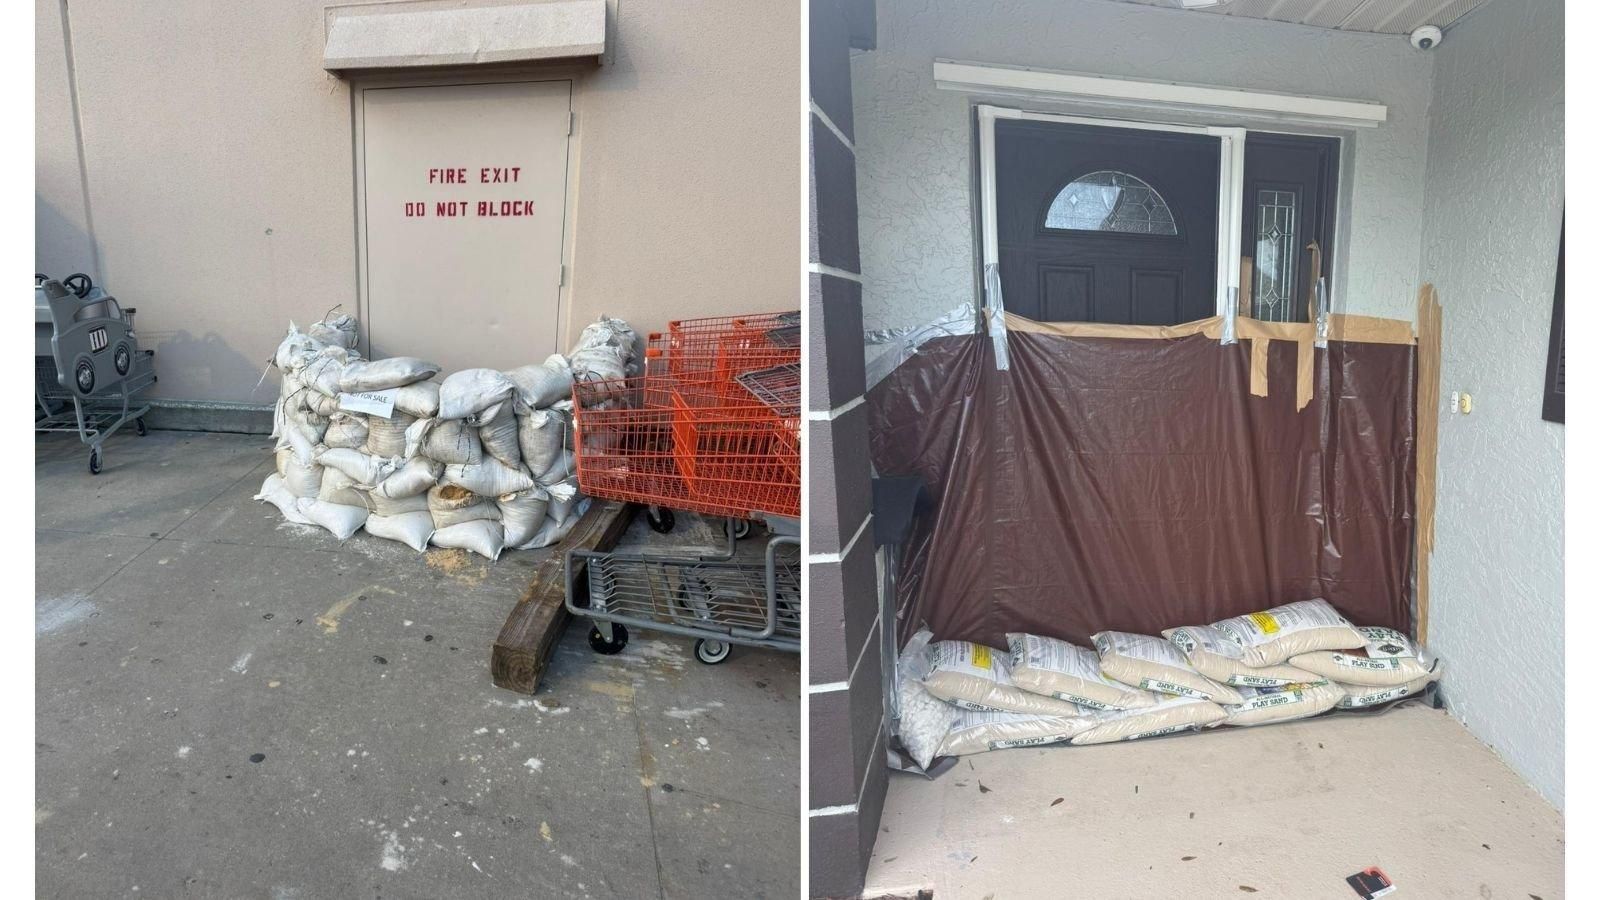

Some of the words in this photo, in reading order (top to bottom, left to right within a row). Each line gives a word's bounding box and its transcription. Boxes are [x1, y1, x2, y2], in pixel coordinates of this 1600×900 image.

[429, 168, 467, 184] FIRE
[480, 167, 521, 183] EXIT
[405, 202, 425, 217] DO
[436, 202, 468, 217] NOT
[477, 201, 534, 216] BLOCK
[361, 392, 372, 400] FOR
[373, 395, 388, 404] SALE
[1243, 676, 1259, 684] SAND
[1156, 682, 1175, 690] SAND
[1176, 686, 1193, 695] PLAY
[1251, 700, 1269, 708] PLAY
[1270, 696, 1289, 705] SAND
[1025, 737, 1045, 745] PLAY
